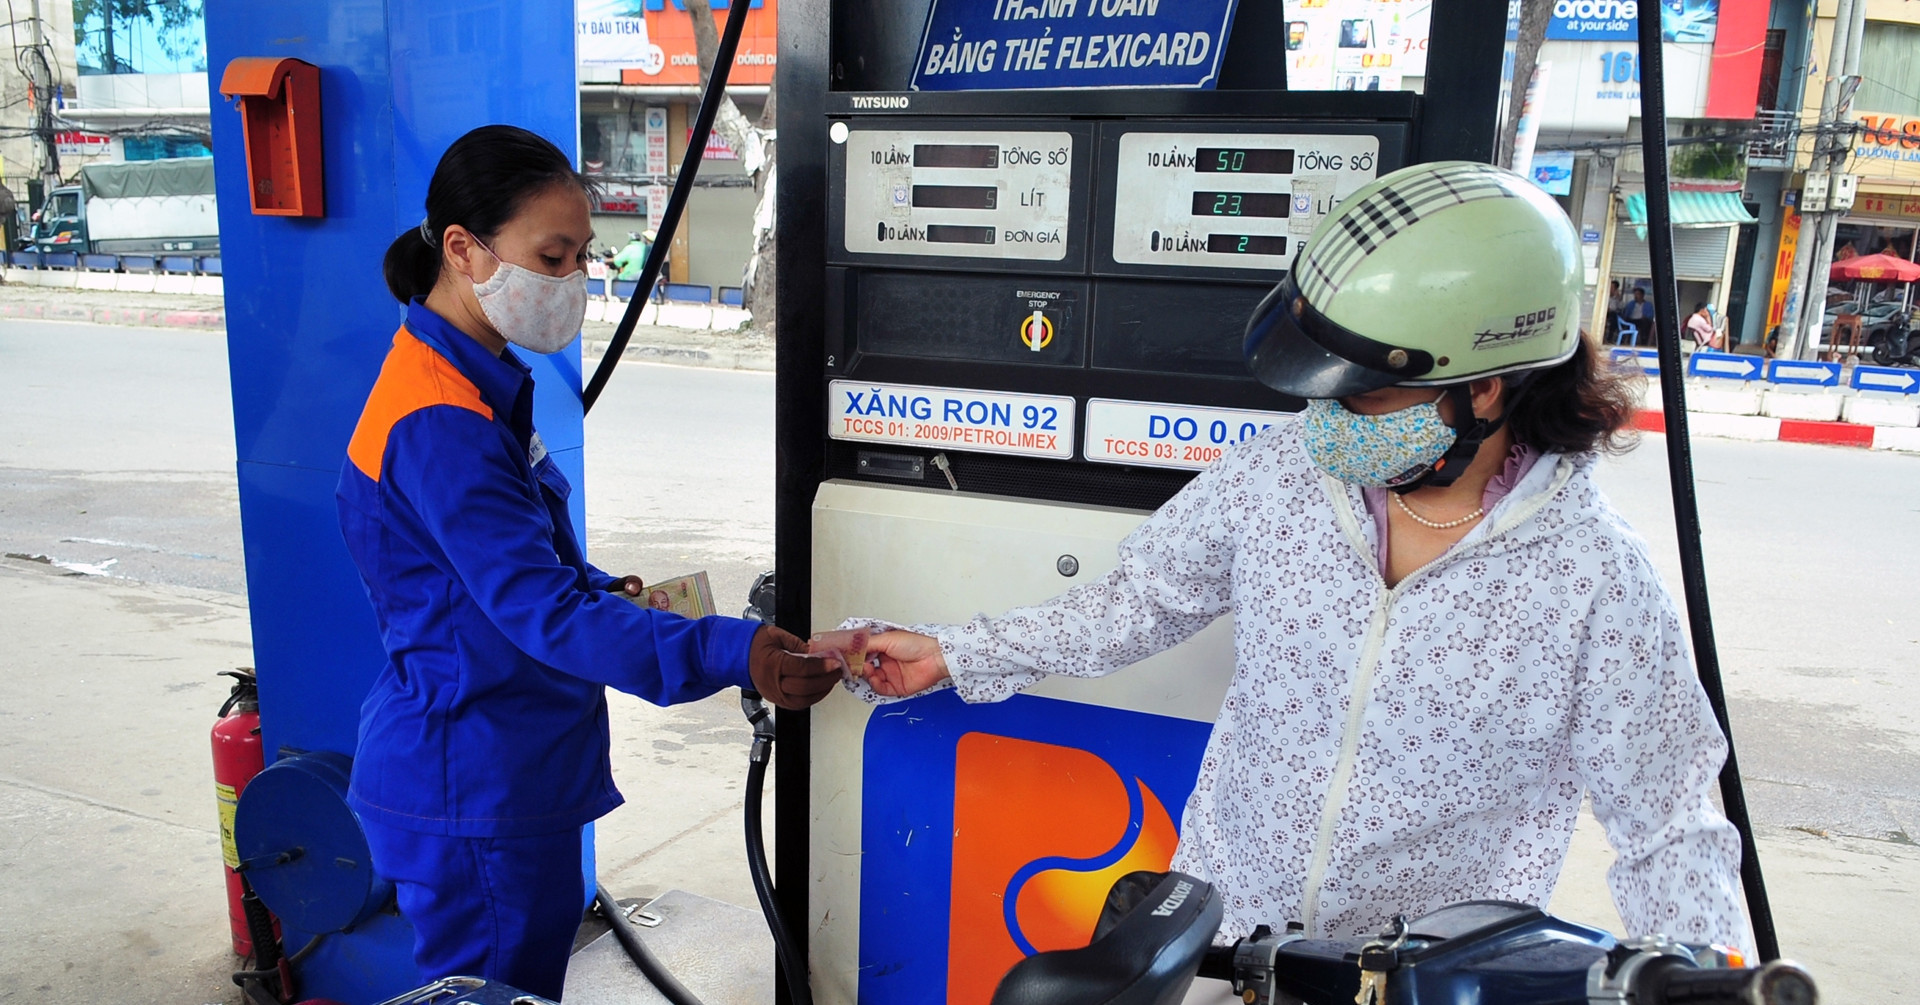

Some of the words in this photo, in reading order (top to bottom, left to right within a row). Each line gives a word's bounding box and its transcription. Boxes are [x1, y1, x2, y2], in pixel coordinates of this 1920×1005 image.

[1566, 20, 1579, 31] at
[1580, 20, 1606, 33] your
[1606, 19, 1630, 32] side
[924, 27, 998, 75] BẰNG
[1003, 26, 1054, 71] THẺ
[1054, 31, 1211, 70] FLEXICARD
[1600, 51, 1641, 83] 16
[852, 96, 909, 109] TATSUNO
[870, 151, 882, 165] 10
[1002, 146, 1042, 165] TỔNG
[1047, 147, 1070, 166] SỐ
[1147, 152, 1159, 168] 10
[1216, 150, 1245, 172] 50
[1298, 150, 1343, 171] TỔNG
[1350, 151, 1375, 171] SỐ
[1020, 187, 1045, 207] LÍT
[1004, 231, 1033, 243] ĐƠN
[1036, 229, 1061, 244] GIÁ
[1162, 237, 1173, 251] 10
[1237, 236, 1249, 252] 2
[1016, 290, 1061, 299] EMERGENCY
[1028, 300, 1048, 308] STOP
[827, 354, 835, 367] 2
[845, 387, 932, 421] XĂNG
[943, 399, 1011, 427] RON
[1022, 405, 1058, 431] 92
[844, 418, 884, 436] TCCS
[888, 422, 910, 438] 01:
[914, 424, 1057, 450] 2009/PETROLIMEX
[1148, 415, 1198, 442] DO
[1209, 419, 1274, 447] 0,0
[1104, 438, 1149, 457] TCCS
[1154, 443, 1178, 460] 03:
[1150, 879, 1195, 917] HONDA
